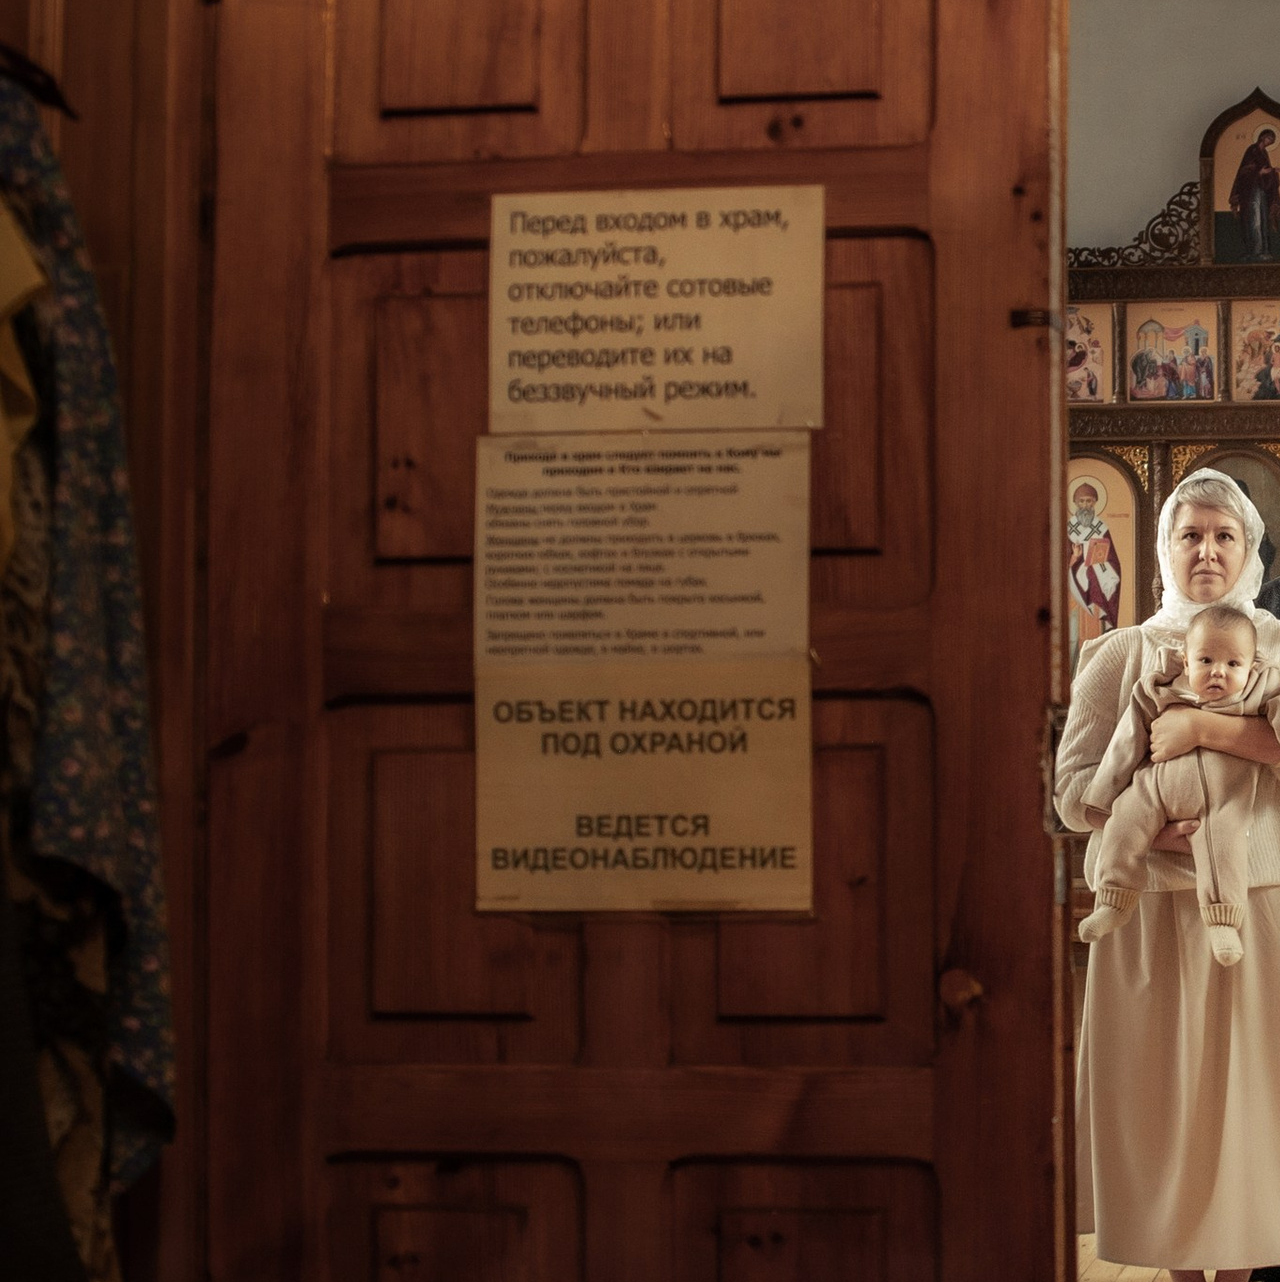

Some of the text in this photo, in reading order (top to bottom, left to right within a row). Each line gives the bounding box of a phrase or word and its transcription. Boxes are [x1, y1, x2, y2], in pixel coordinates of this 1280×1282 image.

[509, 209, 789, 235] Перед входом в храм,
[509, 241, 666, 269] пожалуйста,
[509, 275, 772, 302] отключайте сотовые
[509, 312, 701, 338] телефоны; или
[509, 345, 733, 373] переводите их на
[509, 376, 756, 404] беззвучный режим.
[493, 698, 796, 724] ОБЪЕКТ НАХОДИТСЯ
[542, 726, 748, 758] ПОД ОХРАНОЙ
[576, 814, 710, 841] ВЕДЕТСЯ
[492, 846, 797, 873] ВИДЕОНАБЛЮДЕНИЕ
